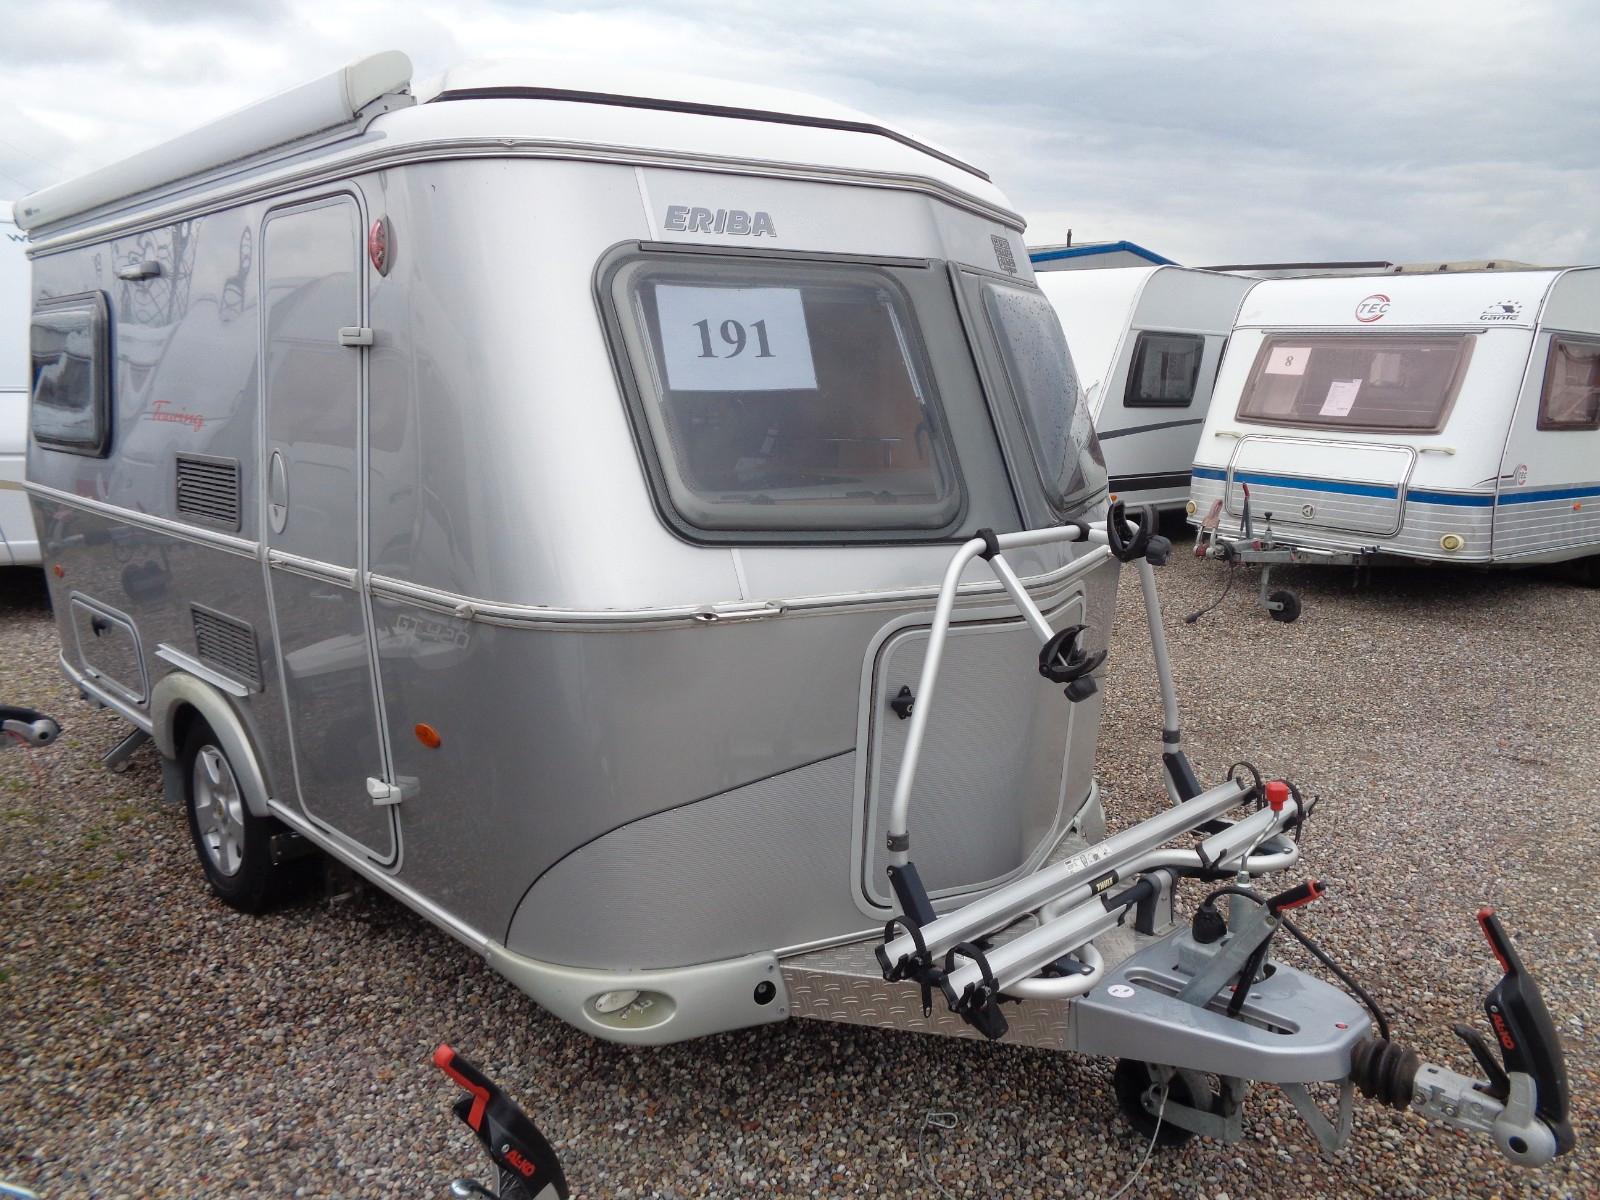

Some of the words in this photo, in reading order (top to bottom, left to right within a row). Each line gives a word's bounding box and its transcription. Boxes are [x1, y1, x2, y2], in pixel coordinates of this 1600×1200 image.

[664, 205, 777, 237] ERIBA
[1360, 303, 1390, 313] TEC
[692, 319, 776, 358] 191
[1285, 356, 1294, 367] 8
